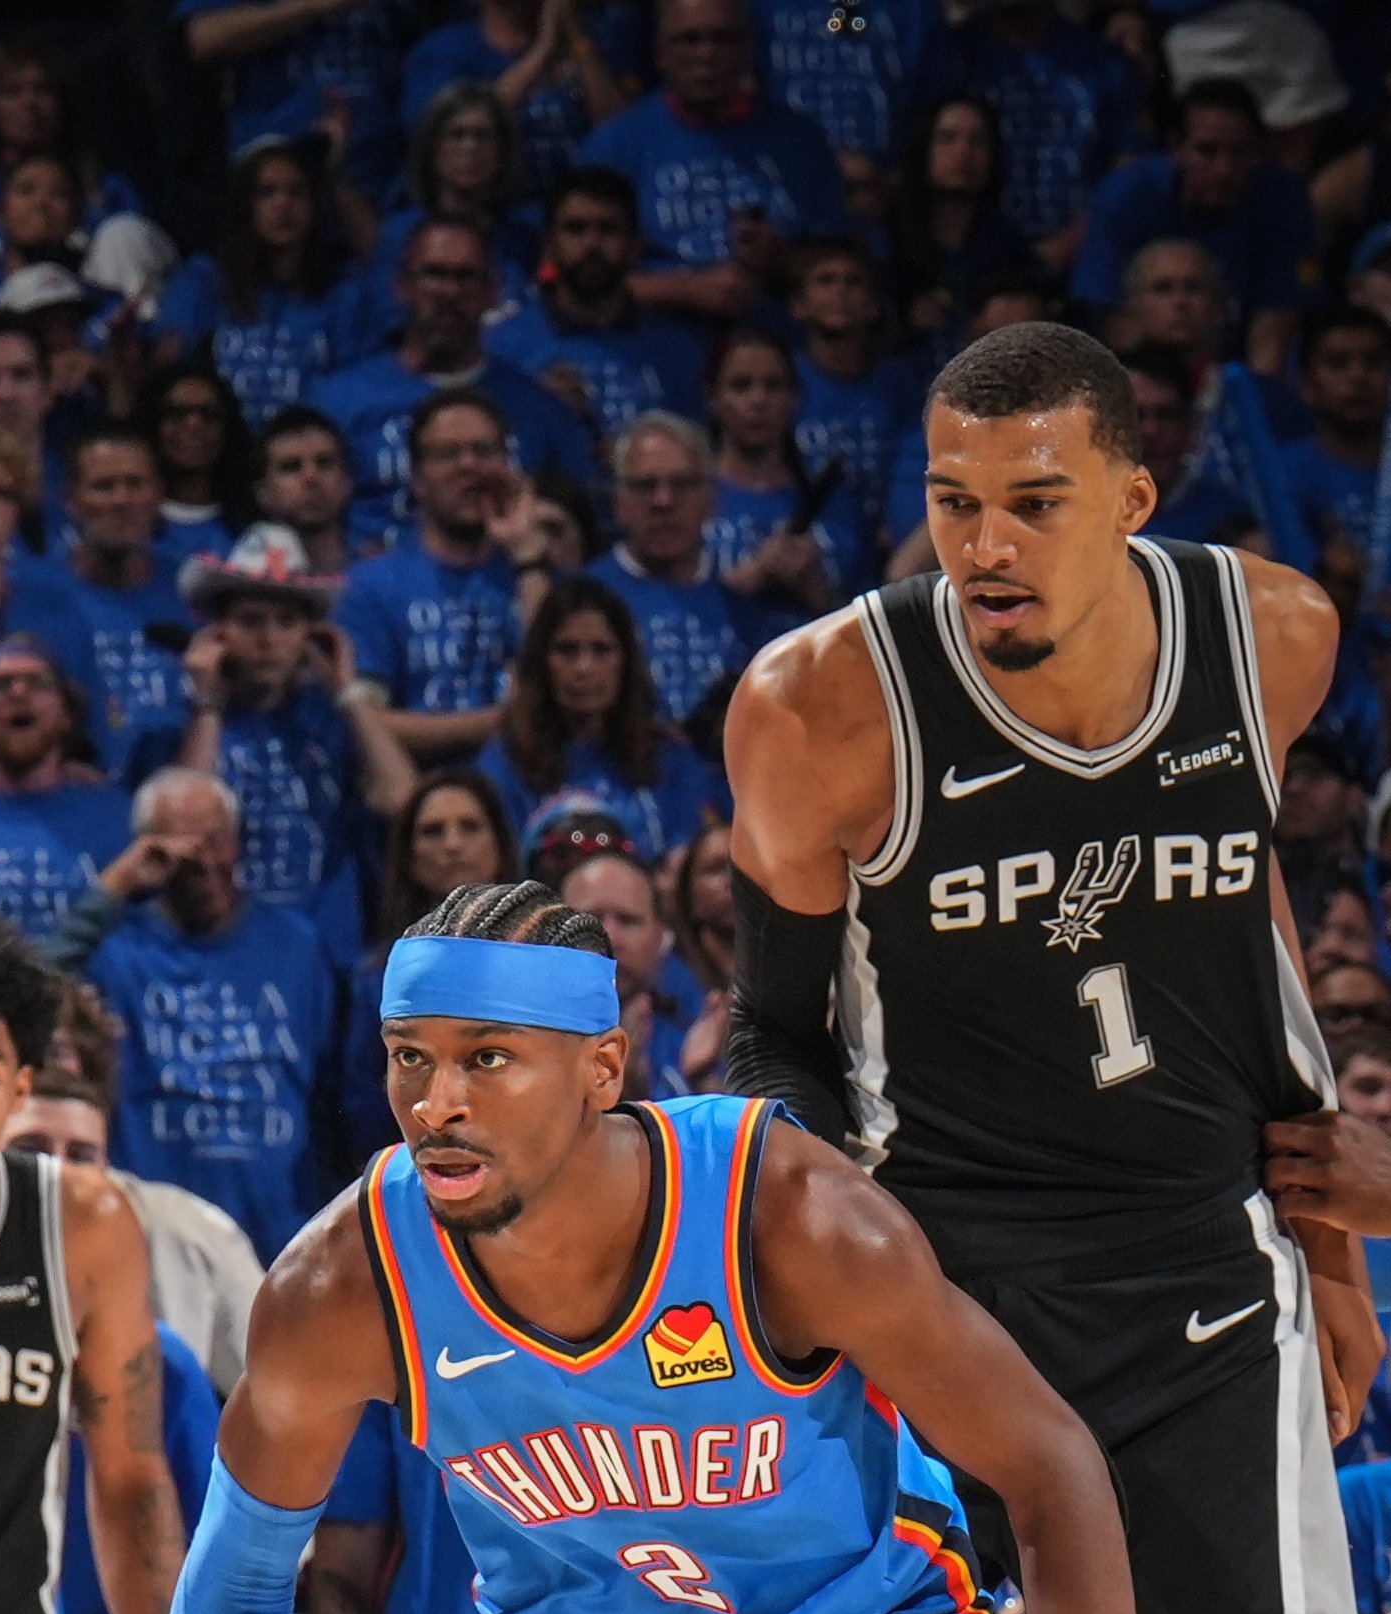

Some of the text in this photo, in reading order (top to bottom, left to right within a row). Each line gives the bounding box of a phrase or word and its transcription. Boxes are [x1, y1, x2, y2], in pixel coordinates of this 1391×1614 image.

[1170, 742, 1233, 776] LEDGER
[1076, 962, 1156, 1090] 1
[445, 1413, 786, 1527] THUNDER
